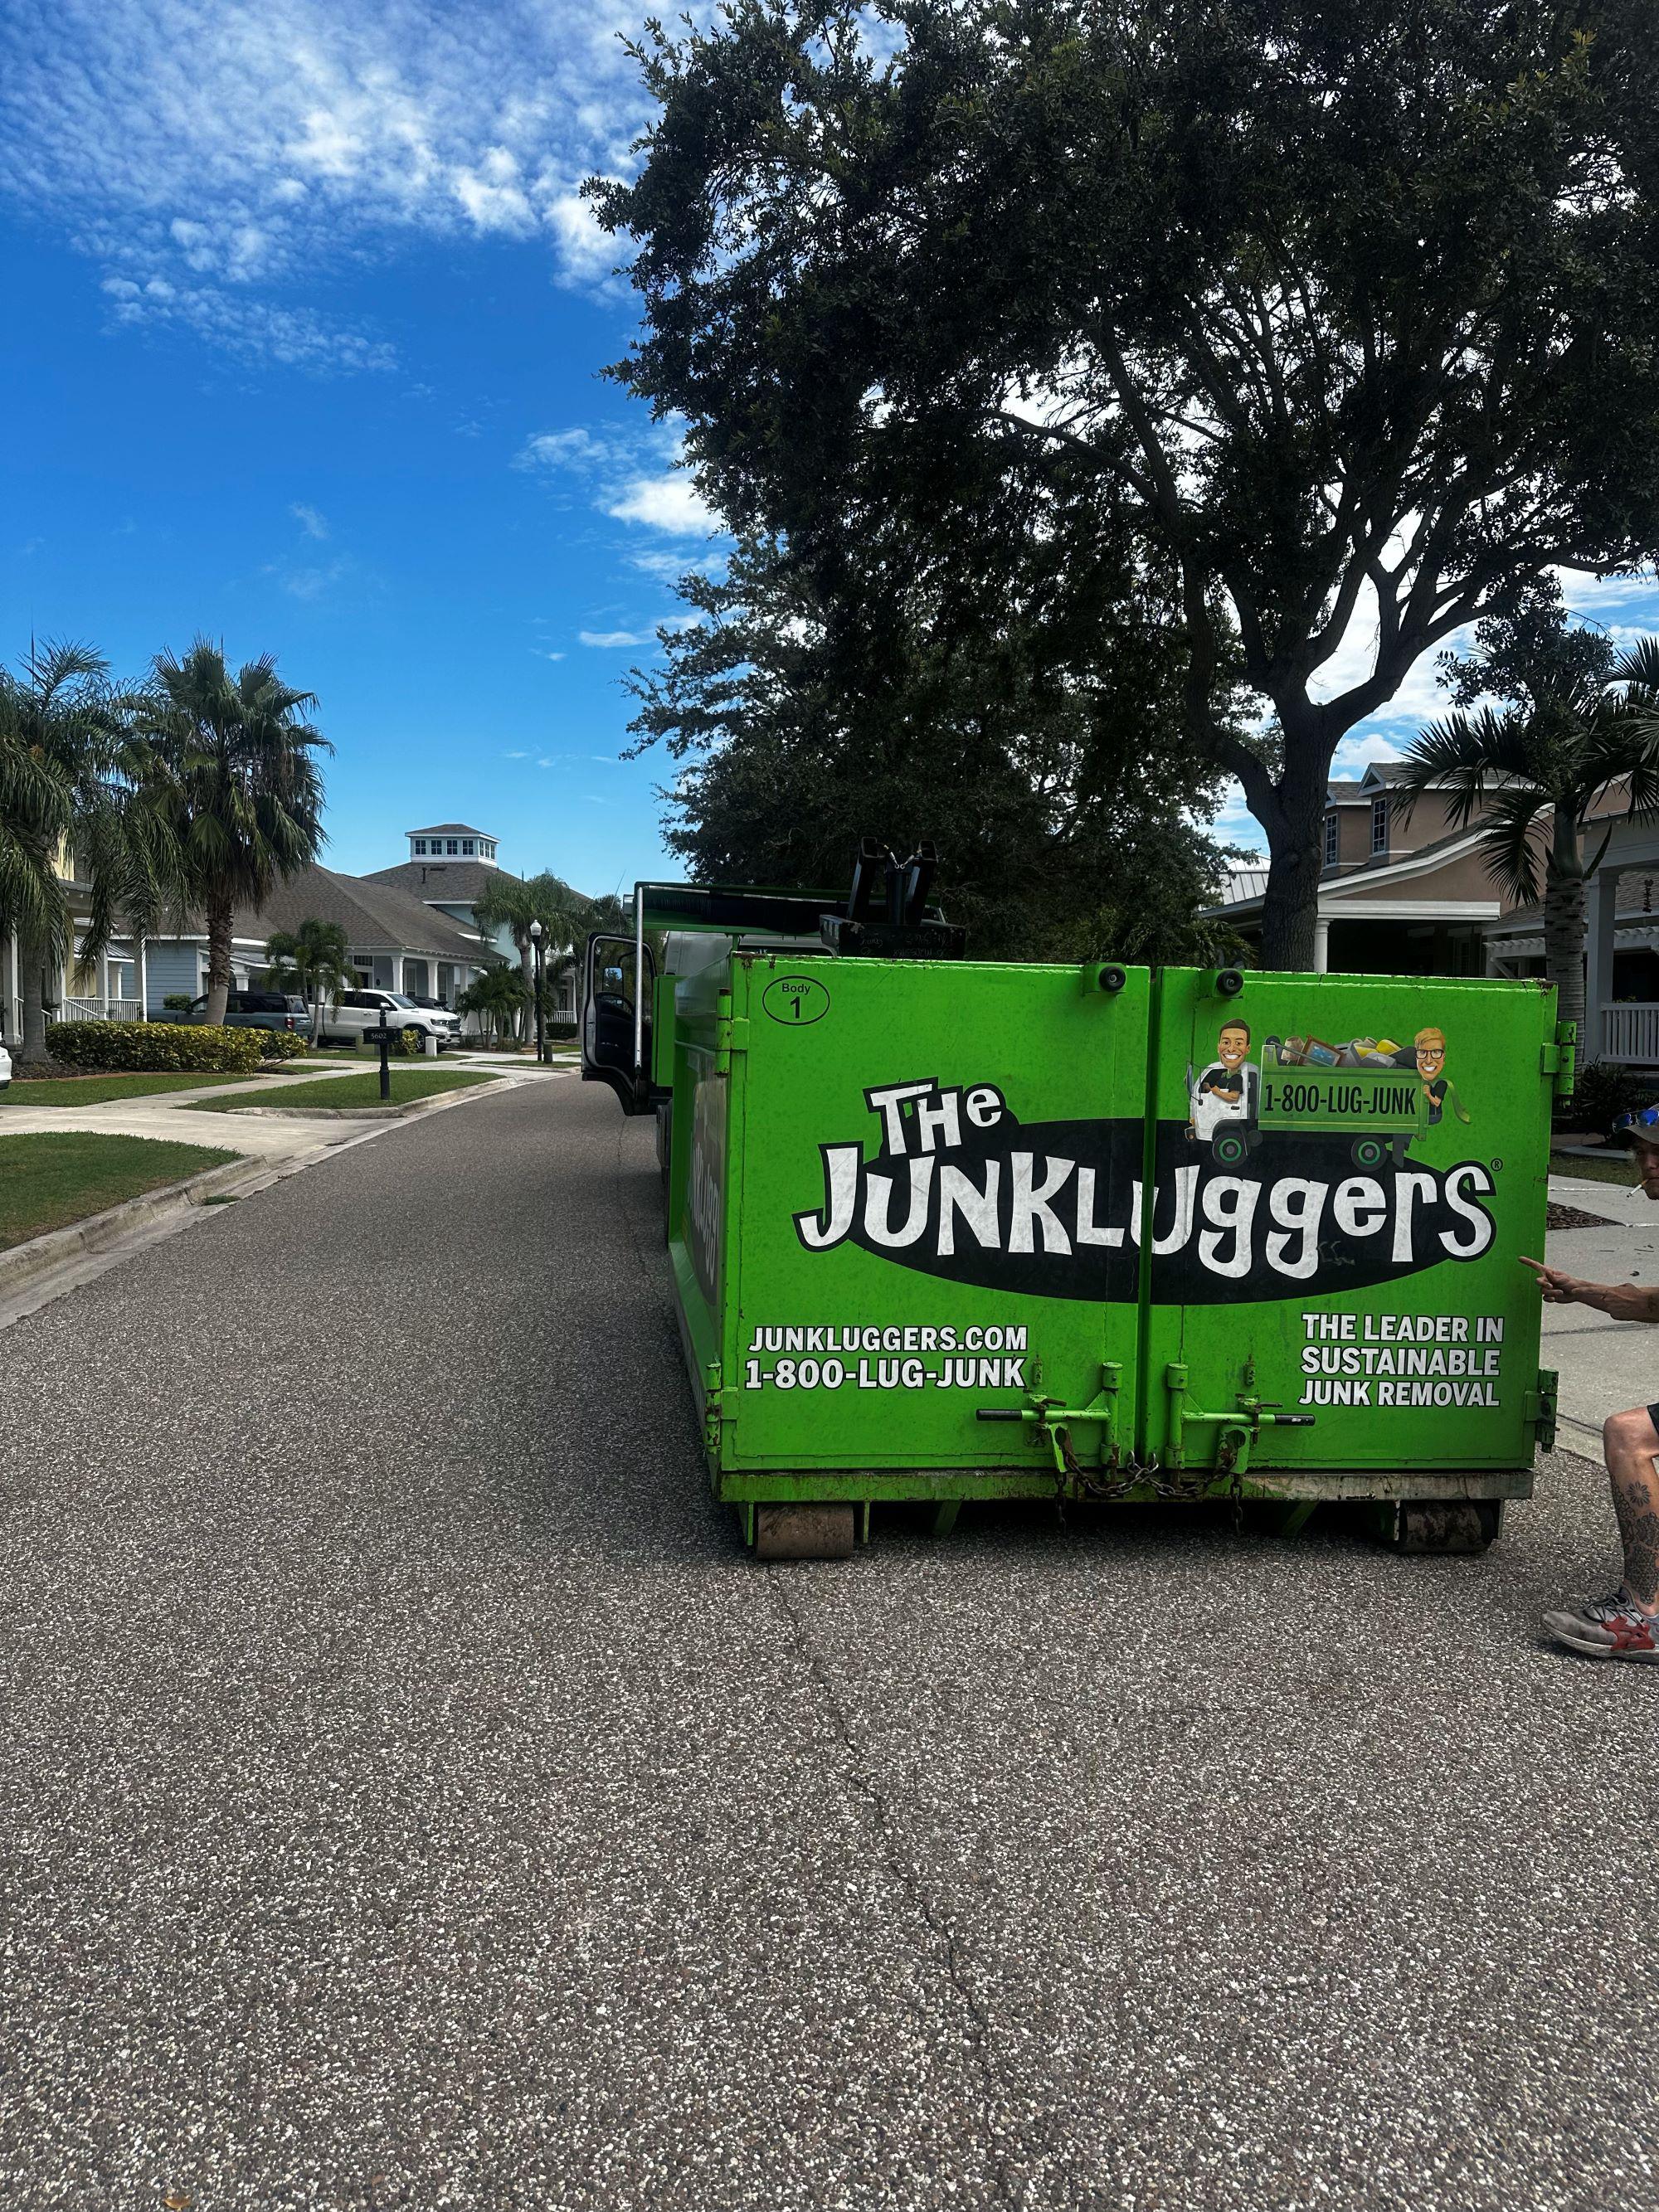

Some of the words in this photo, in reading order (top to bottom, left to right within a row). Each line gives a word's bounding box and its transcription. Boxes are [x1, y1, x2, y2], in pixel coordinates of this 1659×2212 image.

[781, 983, 811, 995] Body
[790, 996, 800, 1019] 1
[1264, 1084, 1417, 1116] 1-800-LUG-JUNK
[748, 1326, 1028, 1353] JUNKLUGGERS.COM
[1301, 1313, 1357, 1340] THE
[1363, 1315, 1469, 1343] LEADER
[1476, 1316, 1505, 1343] IN
[745, 1358, 1026, 1389] 1-800-LUG-JUNK
[1300, 1345, 1501, 1377] SUSTAINABLE
[1298, 1380, 1371, 1406] JUNK
[1377, 1381, 1501, 1407] REMOVAL
